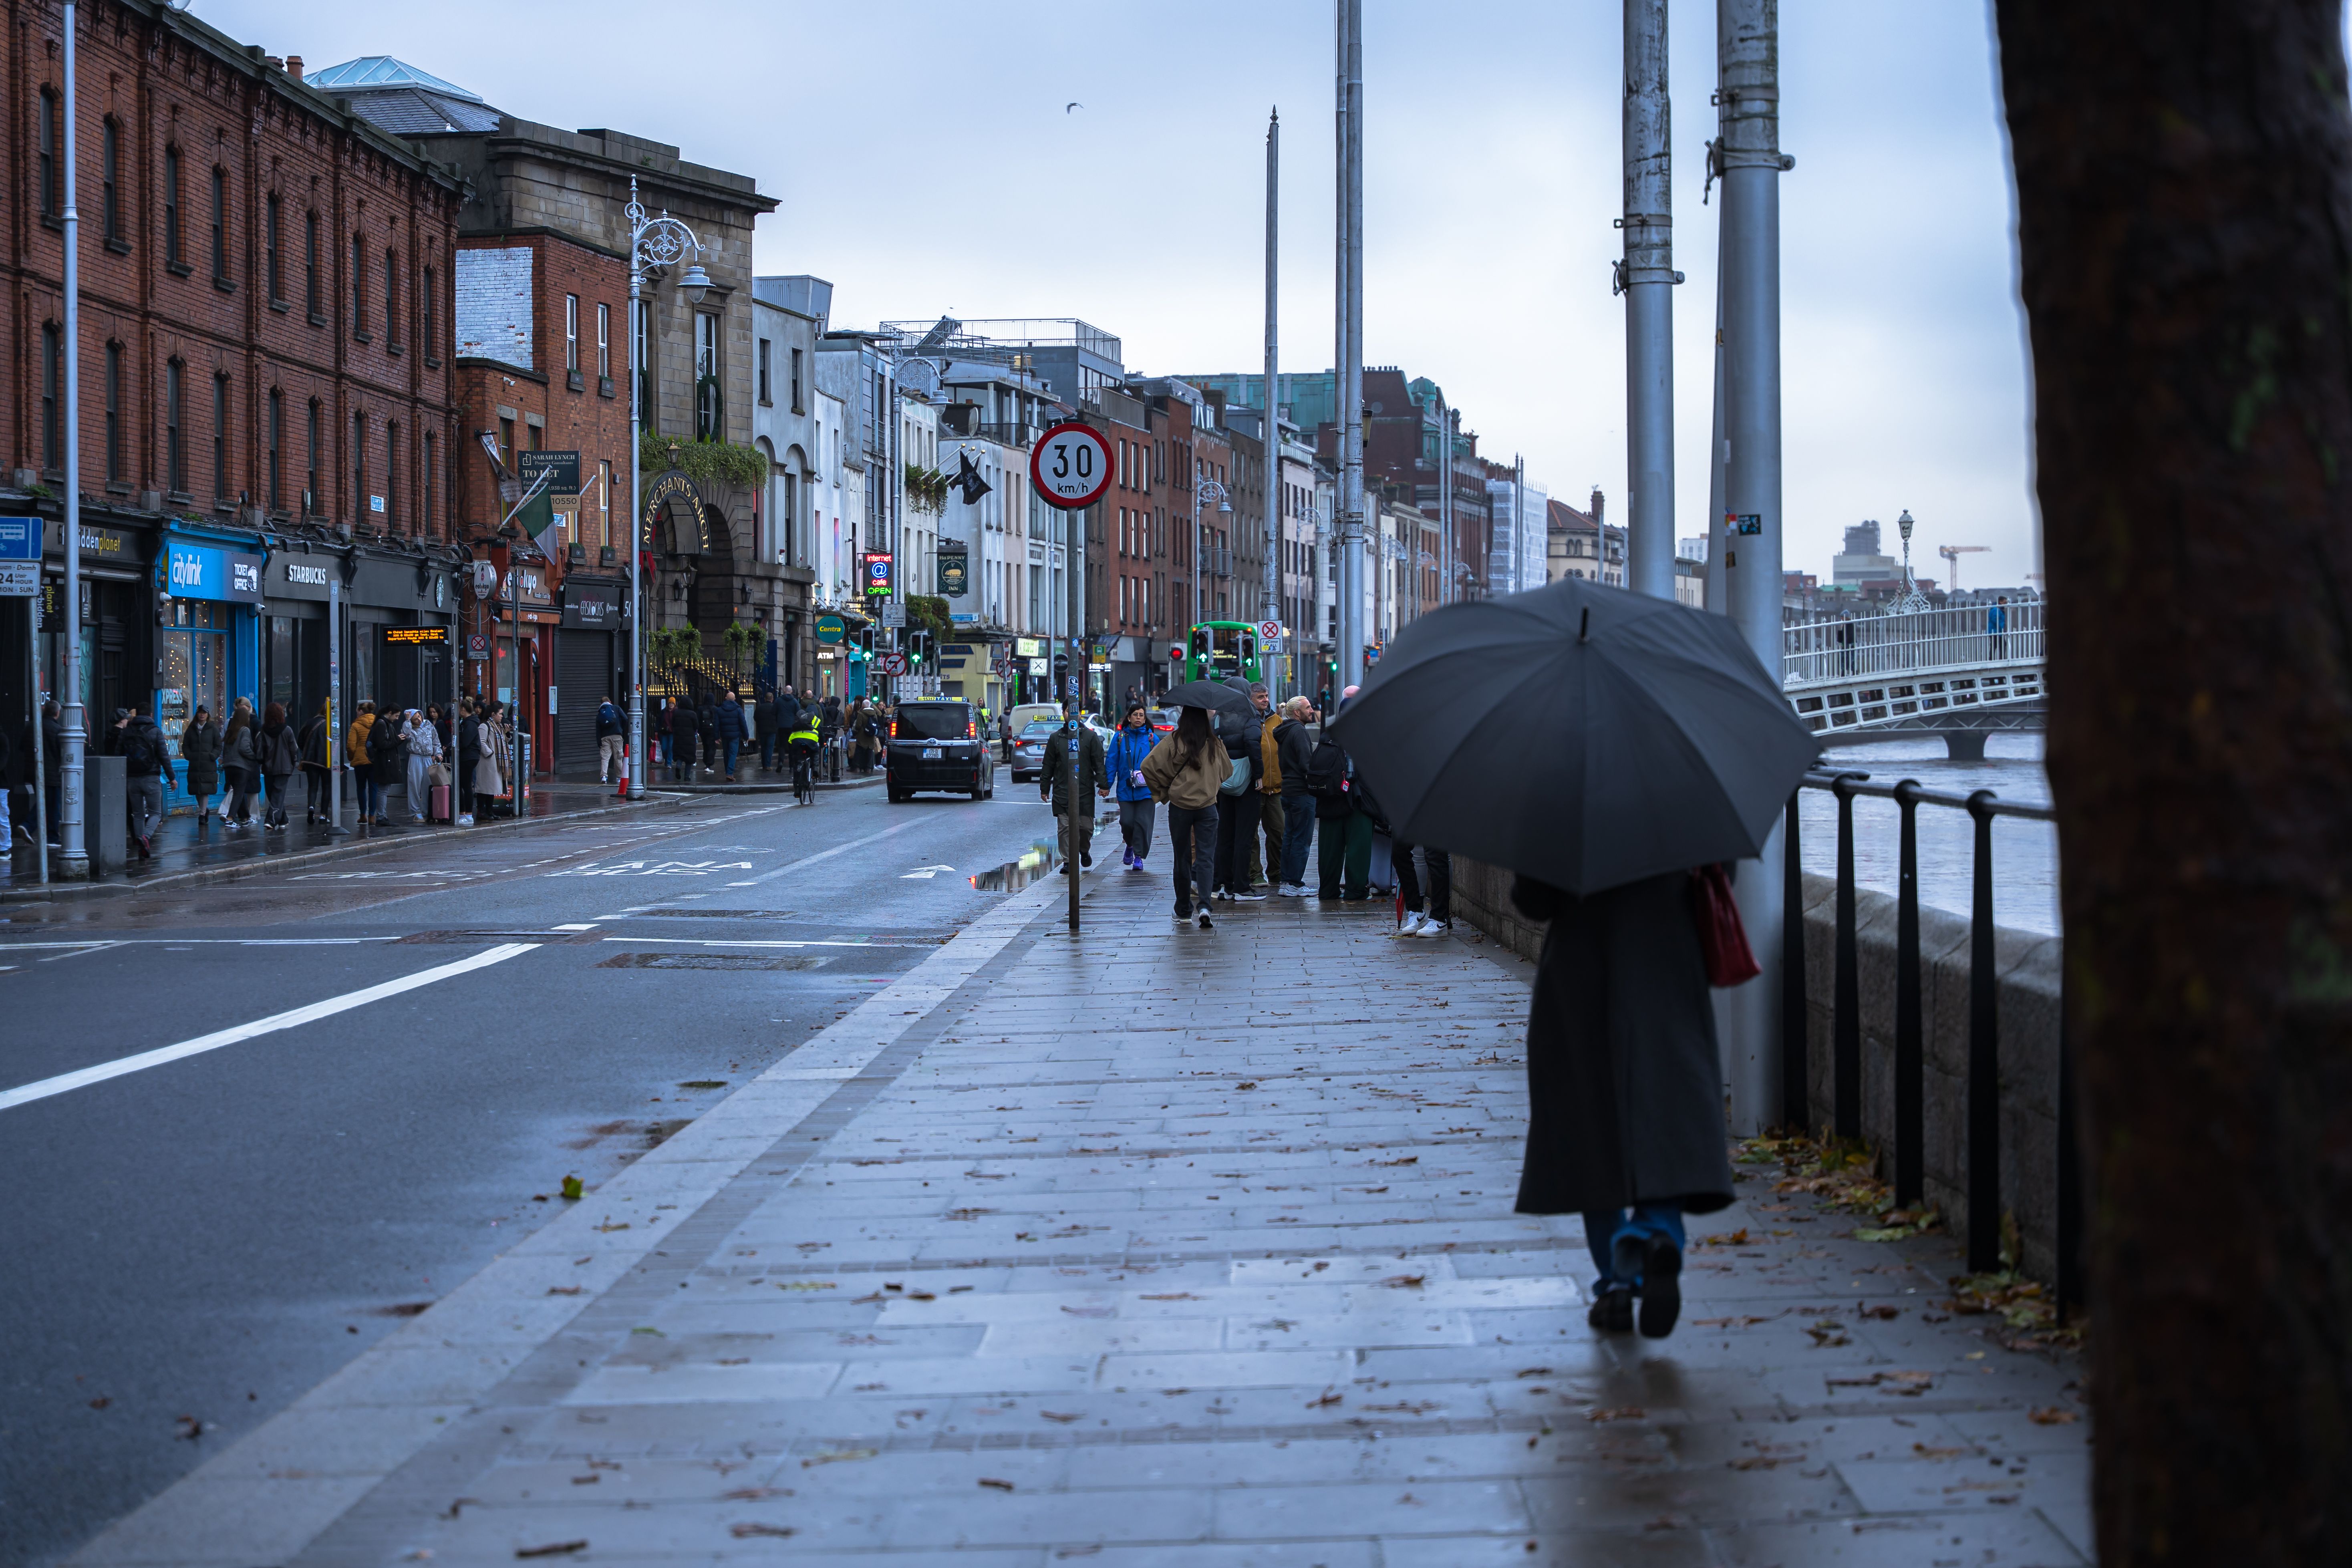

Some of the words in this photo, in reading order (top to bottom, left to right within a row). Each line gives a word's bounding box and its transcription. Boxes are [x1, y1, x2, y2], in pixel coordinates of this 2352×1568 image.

[1053, 444, 1092, 478] 30
[523, 470, 537, 478] TO
[1057, 482, 1088, 494] km/h
[643, 477, 692, 544] MERCHANTS
[692, 497, 709, 552] ARCH
[173, 553, 202, 589] citylink
[234, 564, 248, 576] TICKET
[288, 564, 326, 585] STARBUCKS
[234, 578, 247, 591] OFFICE
[507, 568, 537, 595] etokyo
[45, 586, 55, 613] planet
[581, 601, 604, 616] EASILOCKS
[162, 719, 183, 735] ALWAY
[165, 739, 179, 755] ORK
[286, 871, 487, 880] BUS
[544, 868, 720, 877] BUS
